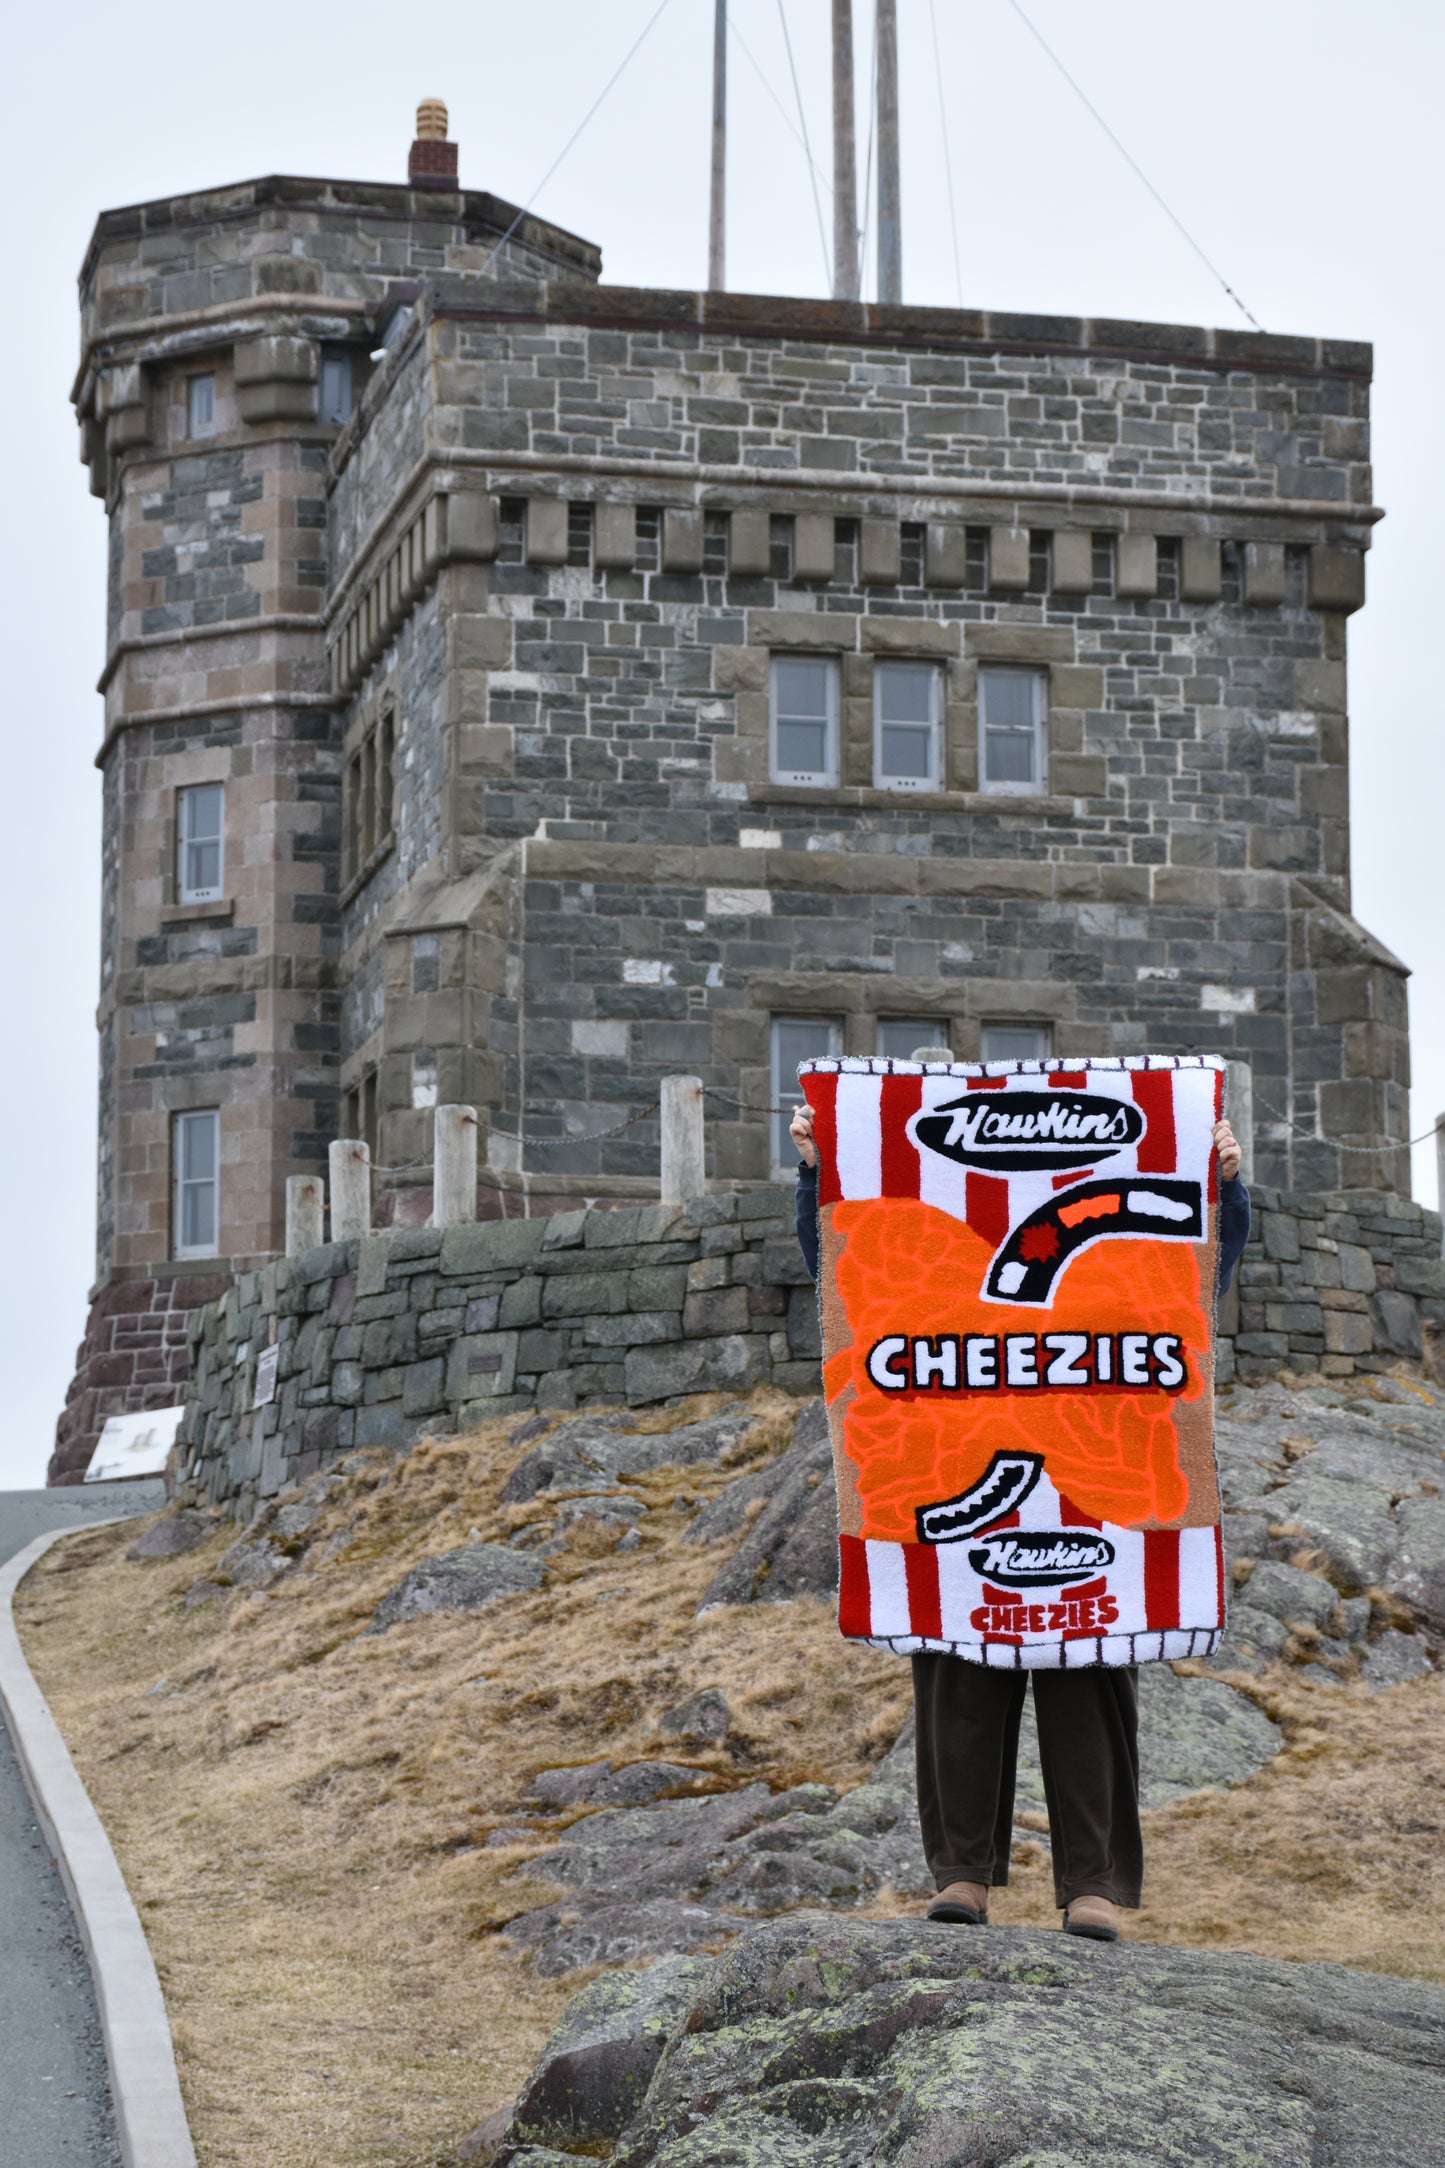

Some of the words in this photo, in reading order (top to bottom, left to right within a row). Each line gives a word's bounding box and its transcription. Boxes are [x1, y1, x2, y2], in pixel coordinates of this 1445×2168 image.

[938, 1102, 1128, 1151] Hawkins
[868, 1333, 1186, 1389] CHEEZIES
[981, 1541, 1110, 1575] Hawkins
[970, 1595, 1119, 1632] CHEEZIES
